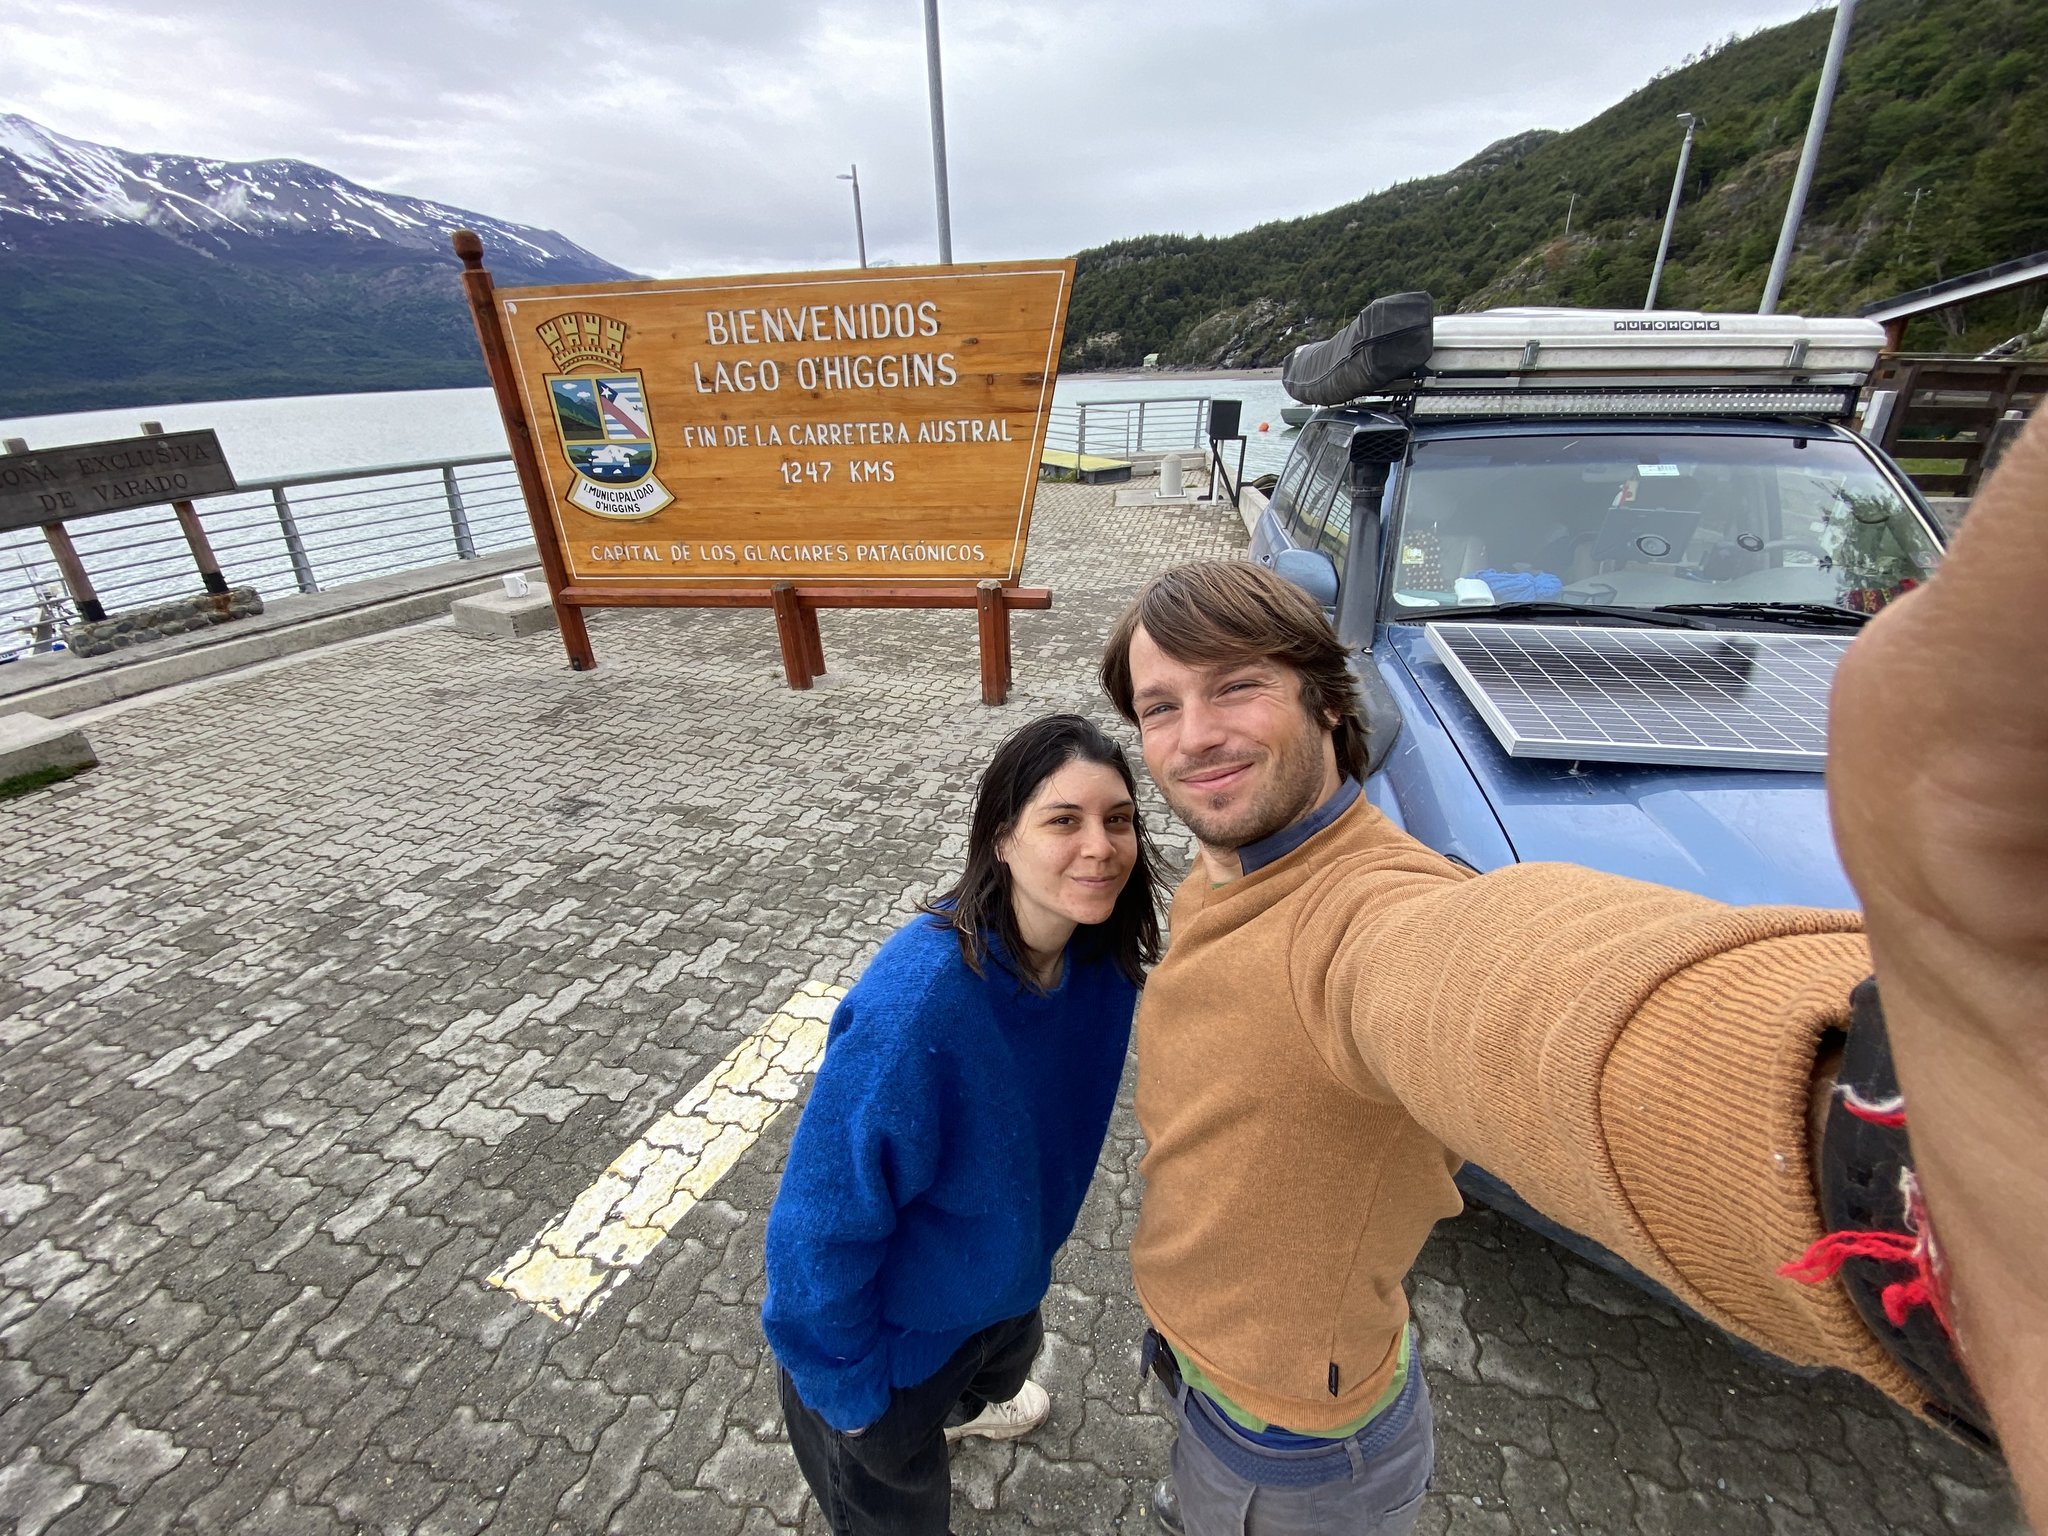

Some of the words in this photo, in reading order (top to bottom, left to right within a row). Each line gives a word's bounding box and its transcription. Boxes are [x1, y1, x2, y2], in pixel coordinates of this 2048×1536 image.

[705, 300, 939, 346] BIENVENIDOS
[1615, 321, 1719, 330] AUTOHOME
[693, 358, 780, 394] LAGO
[797, 352, 957, 391] O'HIGGINS
[683, 425, 718, 449] FIN
[724, 424, 748, 447] DE
[756, 423, 783, 446] LA
[788, 421, 909, 446] CARRETERA
[917, 418, 1013, 443] AUSTRAL
[77, 443, 211, 476] EXCLUSIVA
[780, 461, 832, 484] 1247
[850, 460, 896, 483] KMS
[38, 490, 76, 513] DE
[93, 473, 189, 503] VARADO
[590, 544, 663, 564] CAPITAL
[671, 544, 692, 562] DE
[700, 544, 736, 562] LOS
[743, 544, 848, 562] GLACIARES
[856, 540, 985, 563] PATAGÓNICOS
